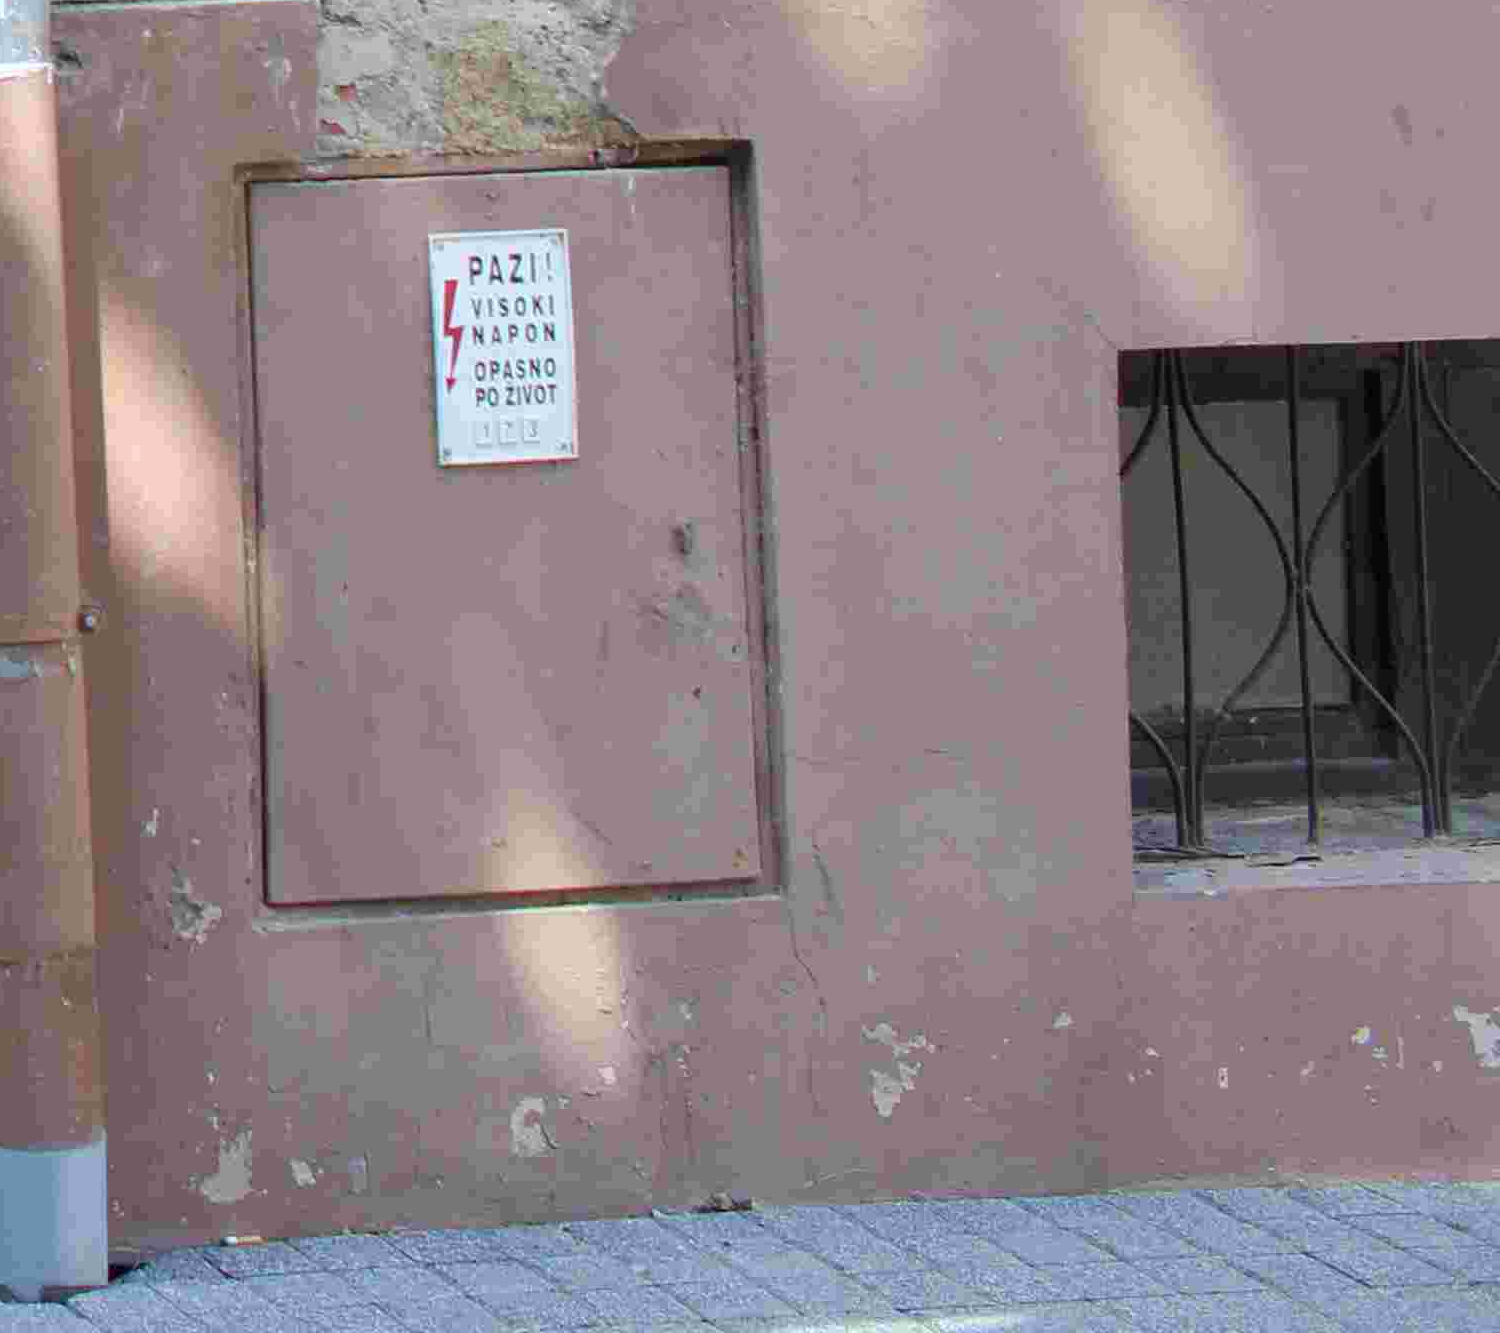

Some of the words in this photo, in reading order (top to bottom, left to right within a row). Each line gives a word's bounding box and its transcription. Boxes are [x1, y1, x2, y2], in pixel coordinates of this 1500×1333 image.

[467, 252, 554, 285] PAZI!
[470, 294, 555, 319] VISOKI
[471, 323, 557, 345] NAPON
[474, 357, 557, 382] OPASNO
[475, 387, 500, 407] PO
